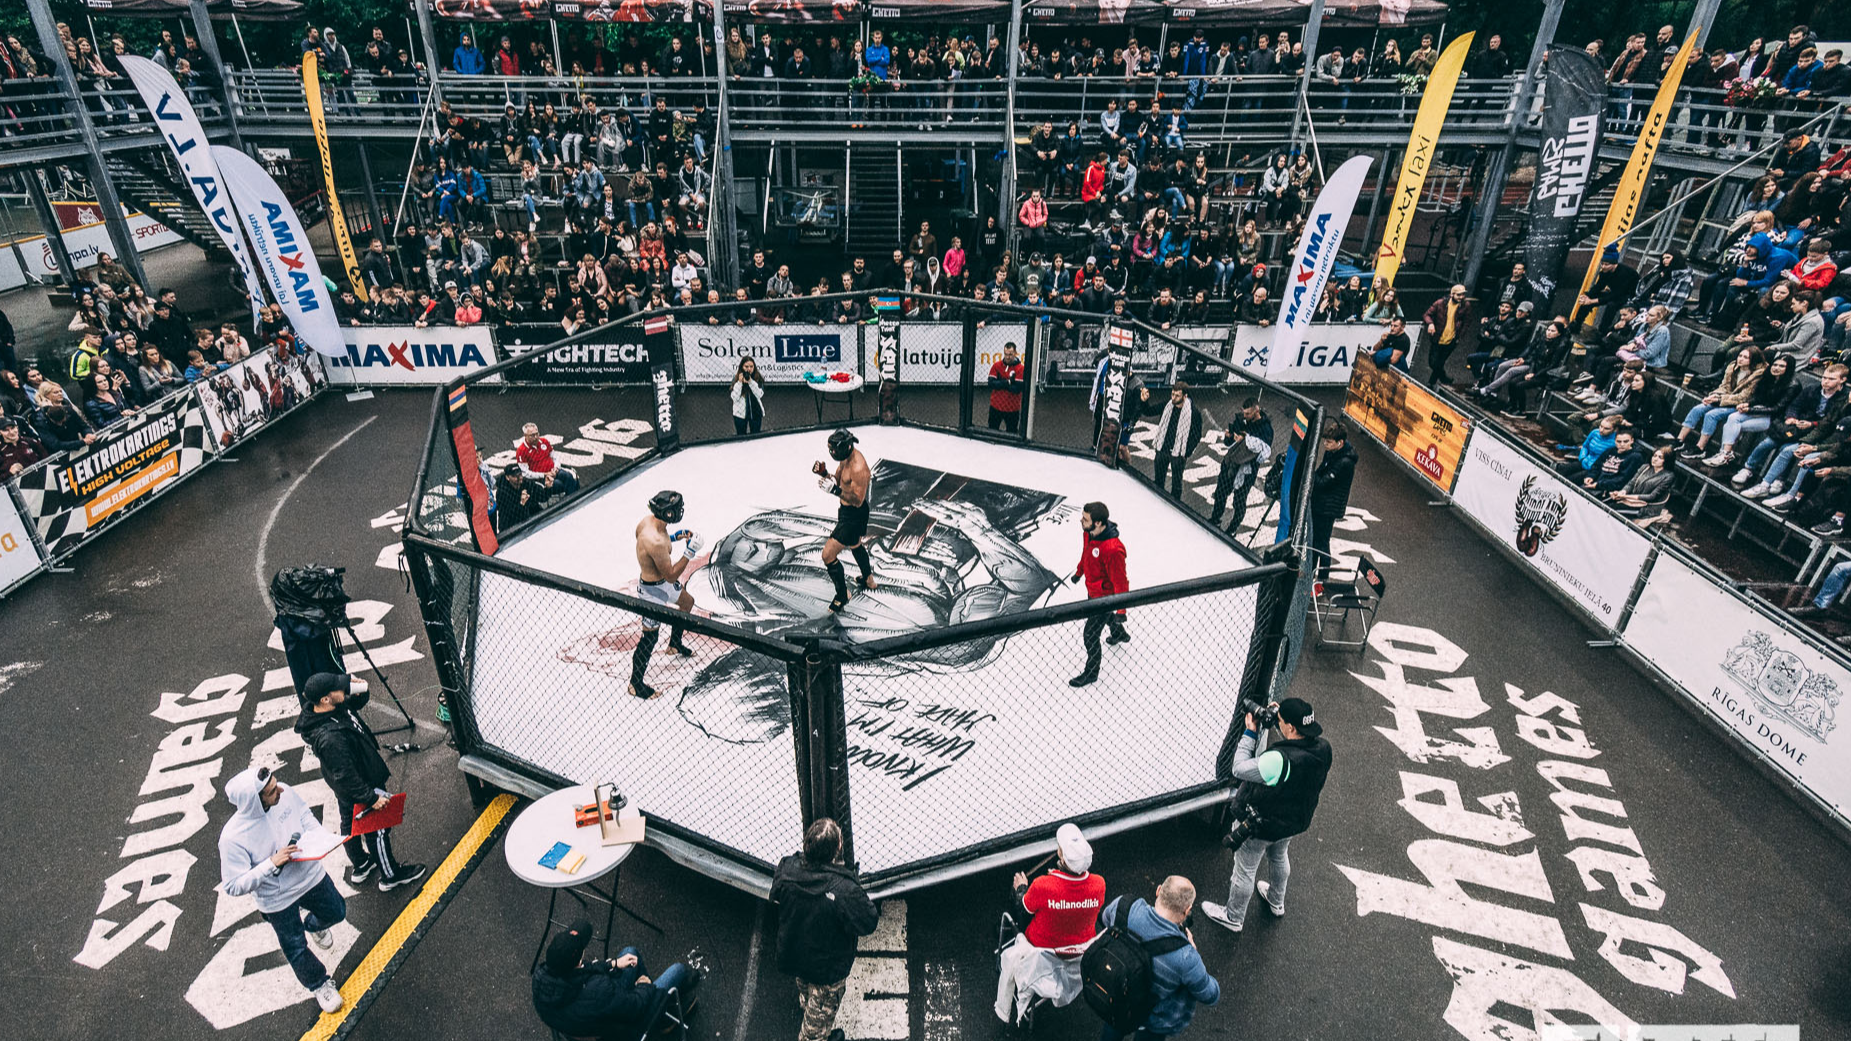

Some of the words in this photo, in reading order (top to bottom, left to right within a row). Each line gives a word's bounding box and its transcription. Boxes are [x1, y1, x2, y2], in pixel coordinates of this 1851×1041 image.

[872, 7, 900, 18] GHETTO
[1637, 113, 1662, 182] nafta
[1285, 213, 1332, 330] MAXIMA
[332, 339, 488, 371] MAXIMA
[698, 338, 772, 358] Solem
[780, 338, 836, 358] Line
[1431, 411, 1453, 433] GHETTO
[58, 412, 177, 495] ELEKTROKARTINGS
[81, 471, 114, 495] HIGH
[115, 439, 170, 475] VOLTAGE
[1474, 447, 1490, 466] VISS
[1602, 602, 1612, 614] 40
[1711, 686, 1755, 727] RĪGAS
[1757, 723, 1808, 767] DOME
[74, 672, 250, 970] games
[1504, 682, 1738, 999] games
[1048, 898, 1099, 910] Hellanodikis
